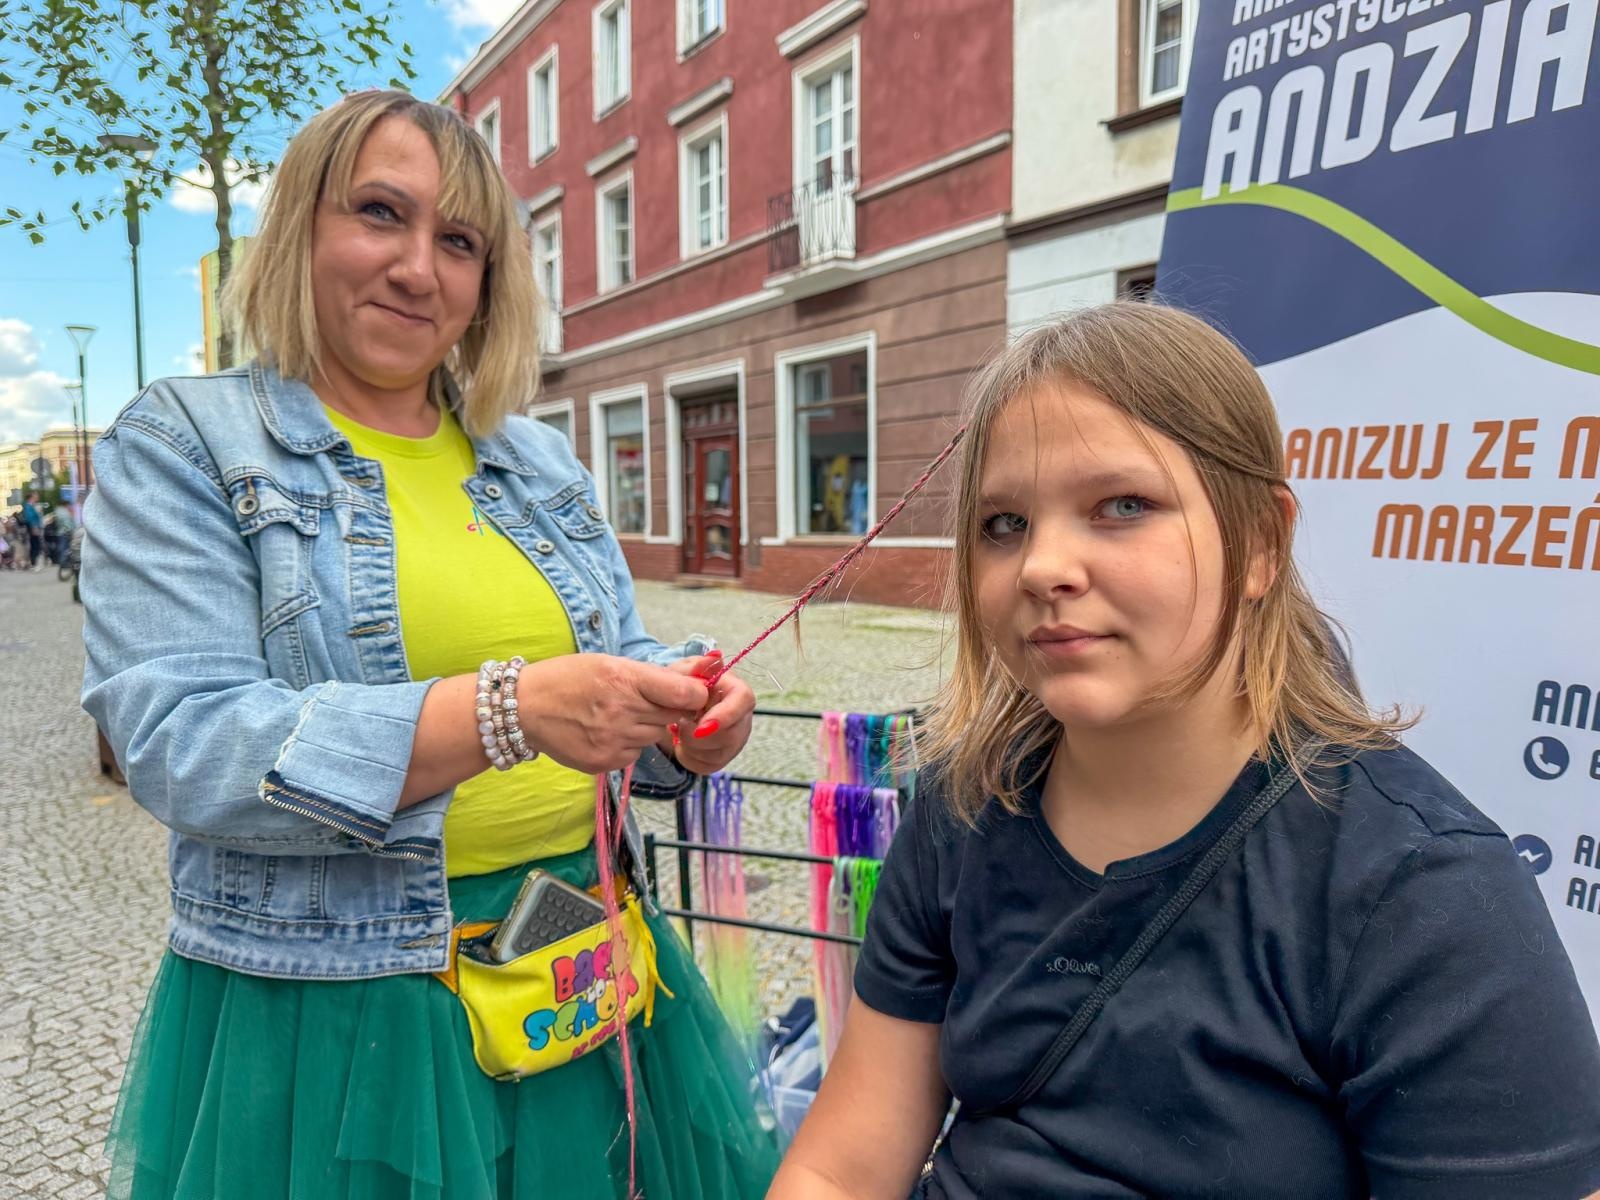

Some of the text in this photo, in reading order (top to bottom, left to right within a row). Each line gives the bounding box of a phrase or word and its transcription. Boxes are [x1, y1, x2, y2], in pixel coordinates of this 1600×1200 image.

[1223, 0, 1452, 81] ARTYSTYC
[1201, 0, 1599, 200] ANDZIA
[1466, 418, 1539, 479] ZE
